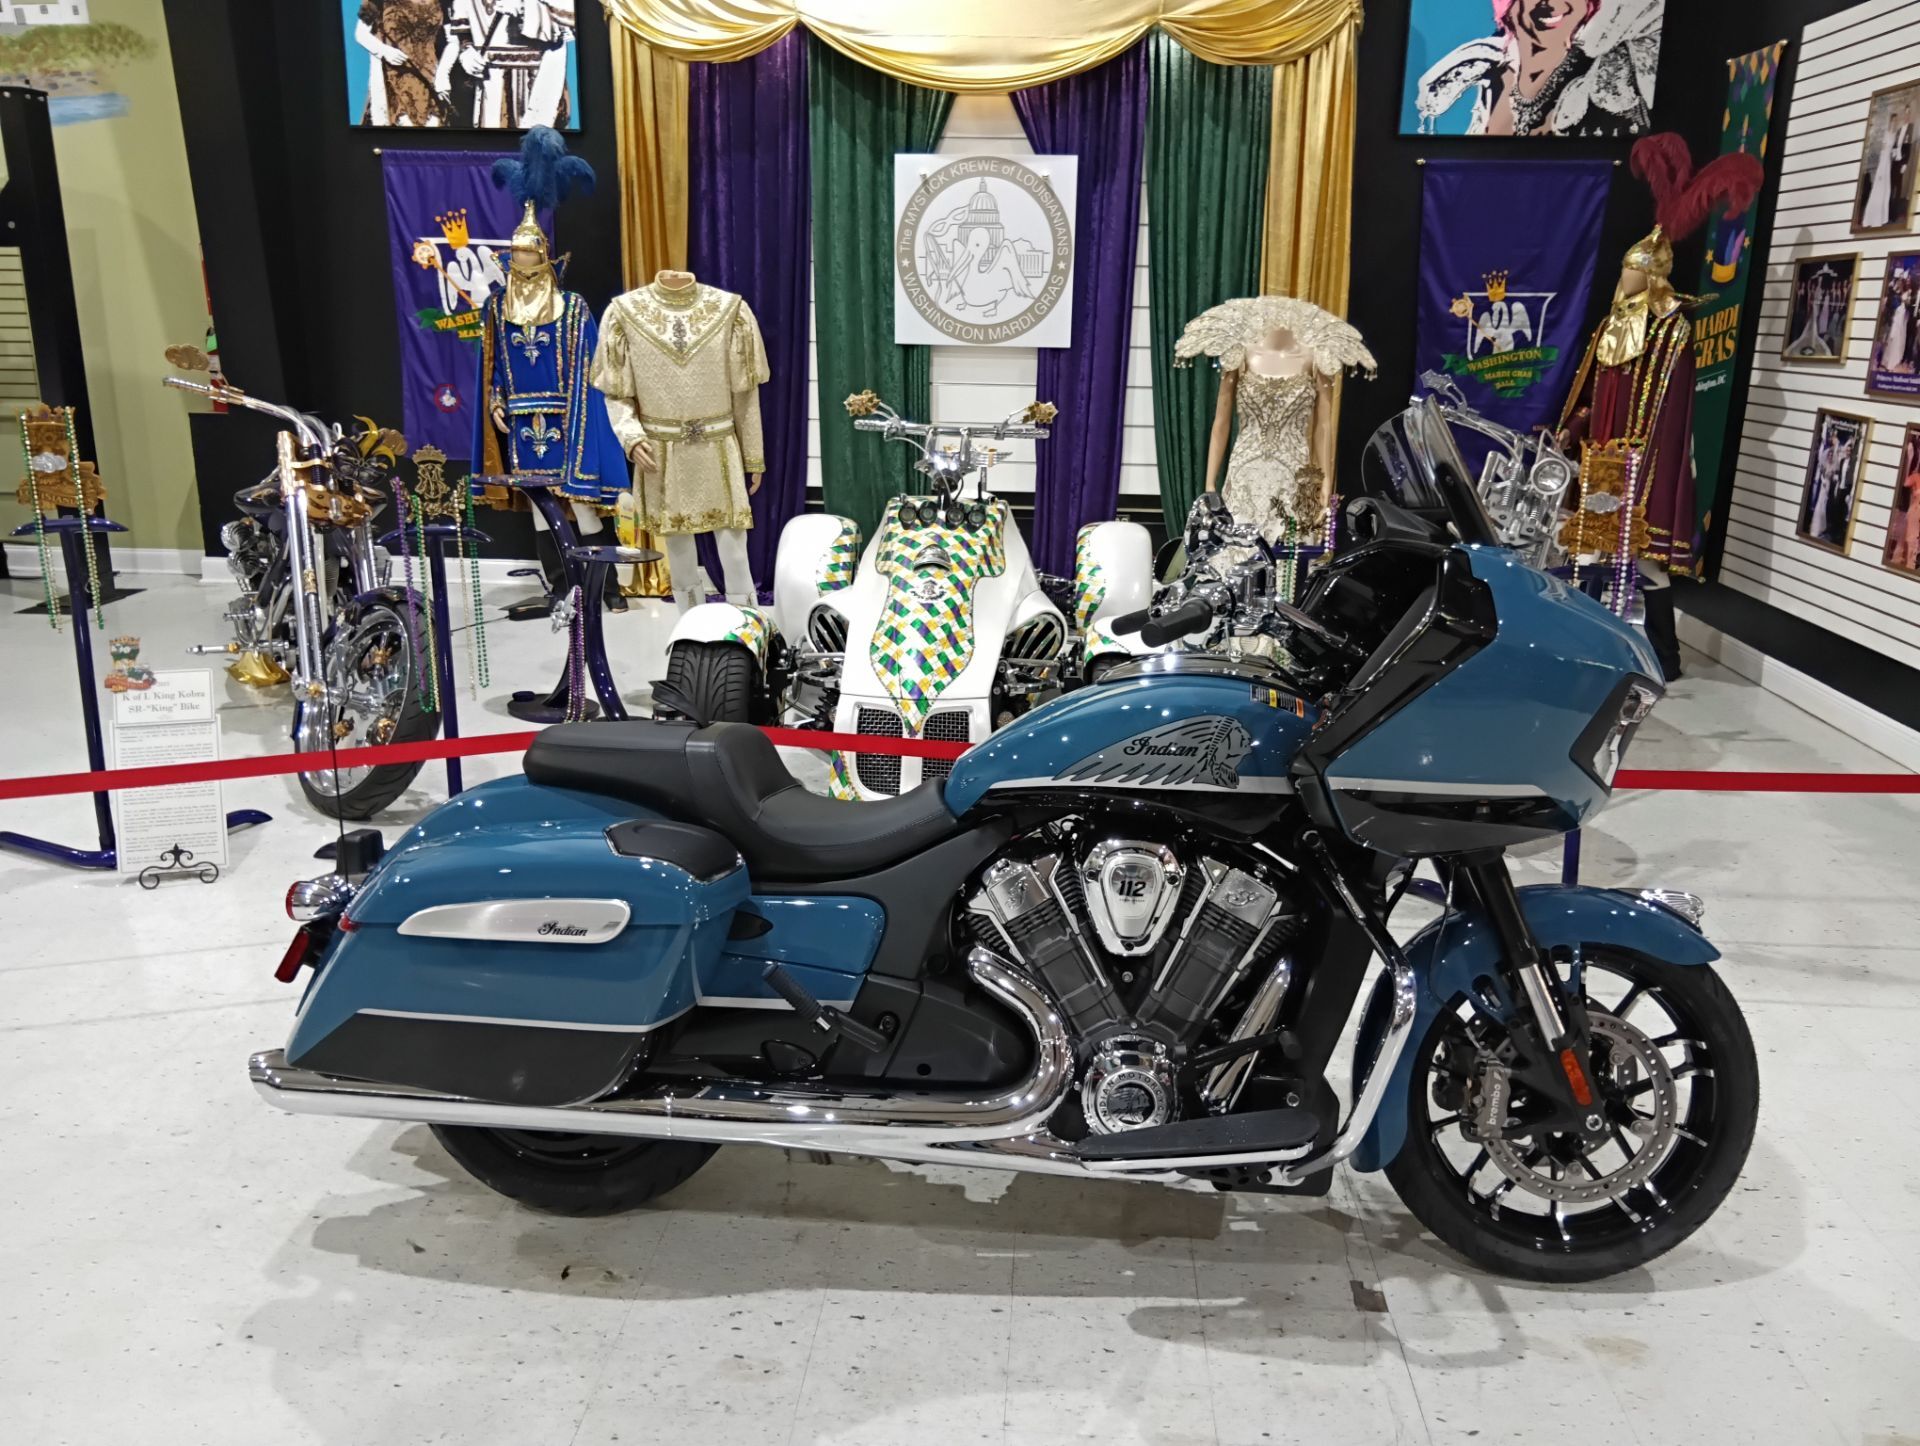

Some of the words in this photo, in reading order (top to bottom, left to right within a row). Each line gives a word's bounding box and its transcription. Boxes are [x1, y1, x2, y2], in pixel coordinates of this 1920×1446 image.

[901, 229, 912, 252] The
[908, 173, 949, 228] MYSTICK
[950, 160, 999, 178] KREWE
[1002, 165, 1016, 175] of
[1017, 168, 1069, 256] LOUISIANIANS
[904, 272, 984, 341] WASHINGTON
[989, 312, 1035, 340] MARDI
[1035, 275, 1065, 315] GRAS
[435, 311, 480, 329] WASHI
[1695, 304, 1740, 340] MARDI
[1694, 330, 1737, 368] GRAS
[1467, 350, 1542, 371] WASHINGTON
[154, 692, 175, 700] King
[178, 690, 205, 698] Kobra
[180, 702, 200, 711] Bike
[1123, 735, 1199, 757] Indian
[1119, 880, 1146, 896] 112
[537, 920, 588, 937] Indian
[1100, 1080, 1115, 1122] INDIAN
[1486, 1083, 1501, 1126] brembo
